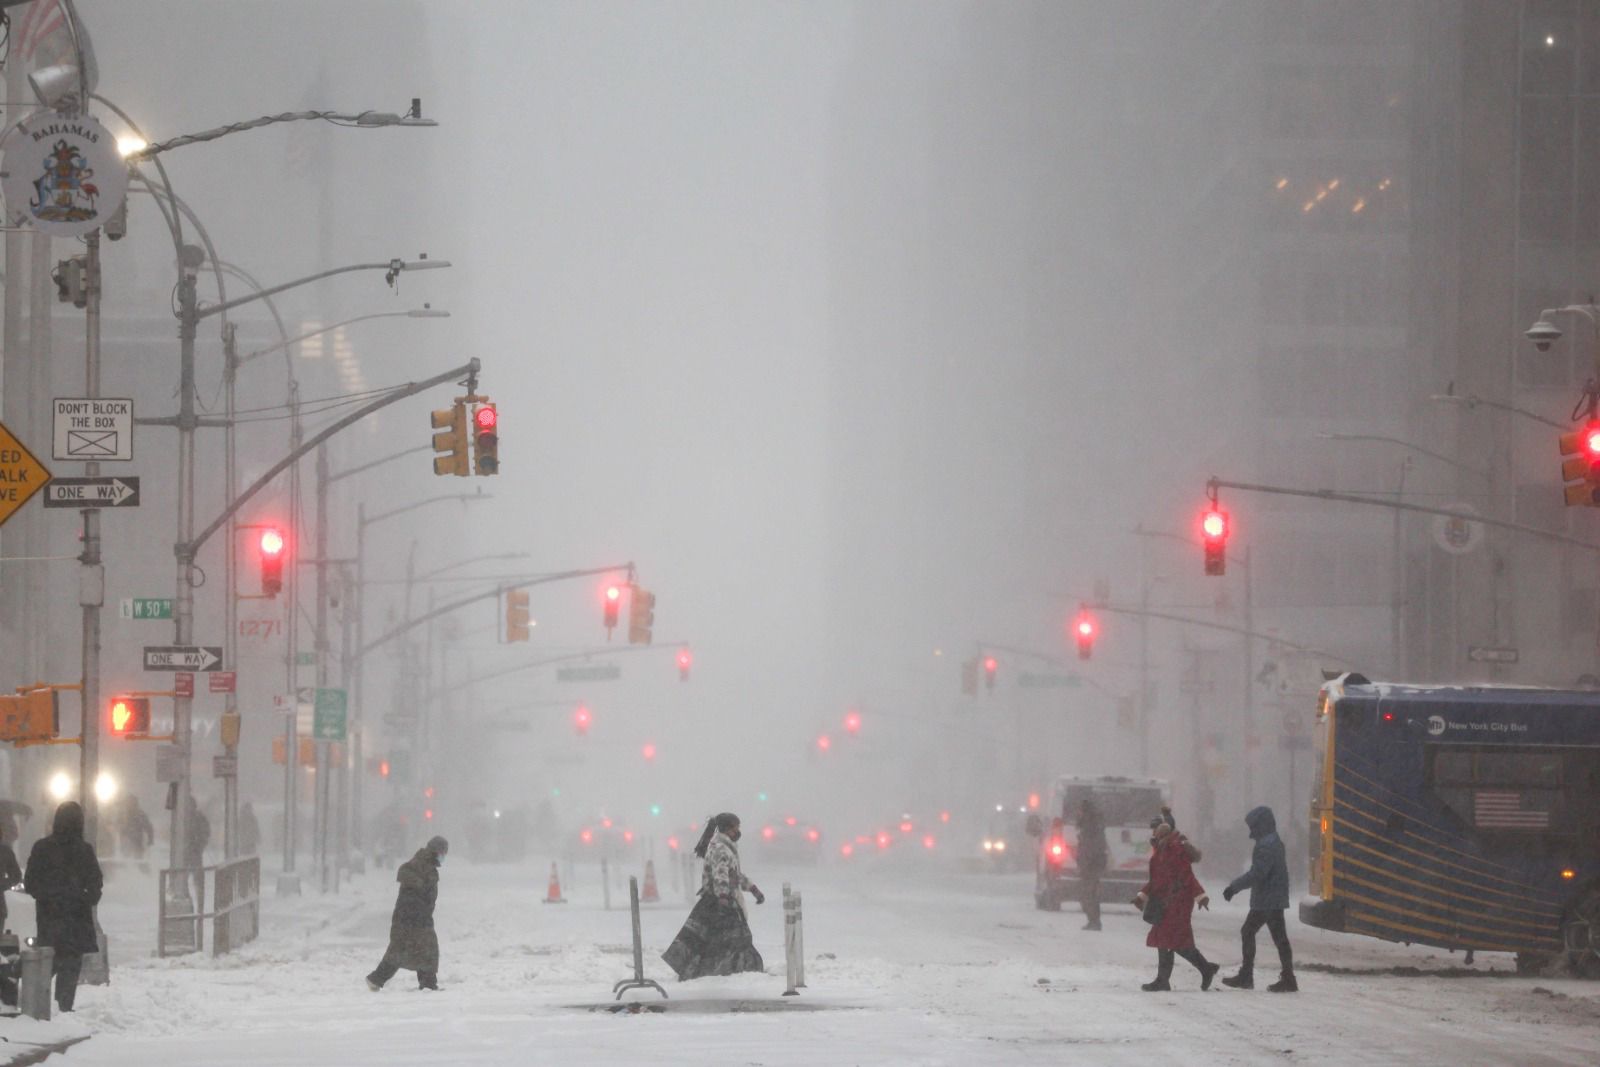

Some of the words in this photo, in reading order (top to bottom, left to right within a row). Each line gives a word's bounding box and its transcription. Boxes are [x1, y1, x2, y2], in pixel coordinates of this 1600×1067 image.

[32, 124, 99, 143] BAHAMAS
[58, 403, 88, 415] DON'T
[93, 403, 127, 415] BLOCK
[71, 417, 91, 428] THE
[95, 417, 115, 428] BOX
[57, 486, 85, 499] ONE
[97, 486, 125, 499] WAY
[134, 601, 143, 616] W
[146, 601, 160, 617] 50
[240, 620, 281, 639] 1271
[151, 654, 173, 665] ONE
[184, 654, 207, 665] WAY
[1448, 721, 1467, 730] New
[1469, 722, 1488, 731] York
[1490, 723, 1508, 733] City
[1510, 724, 1528, 732] Bus
